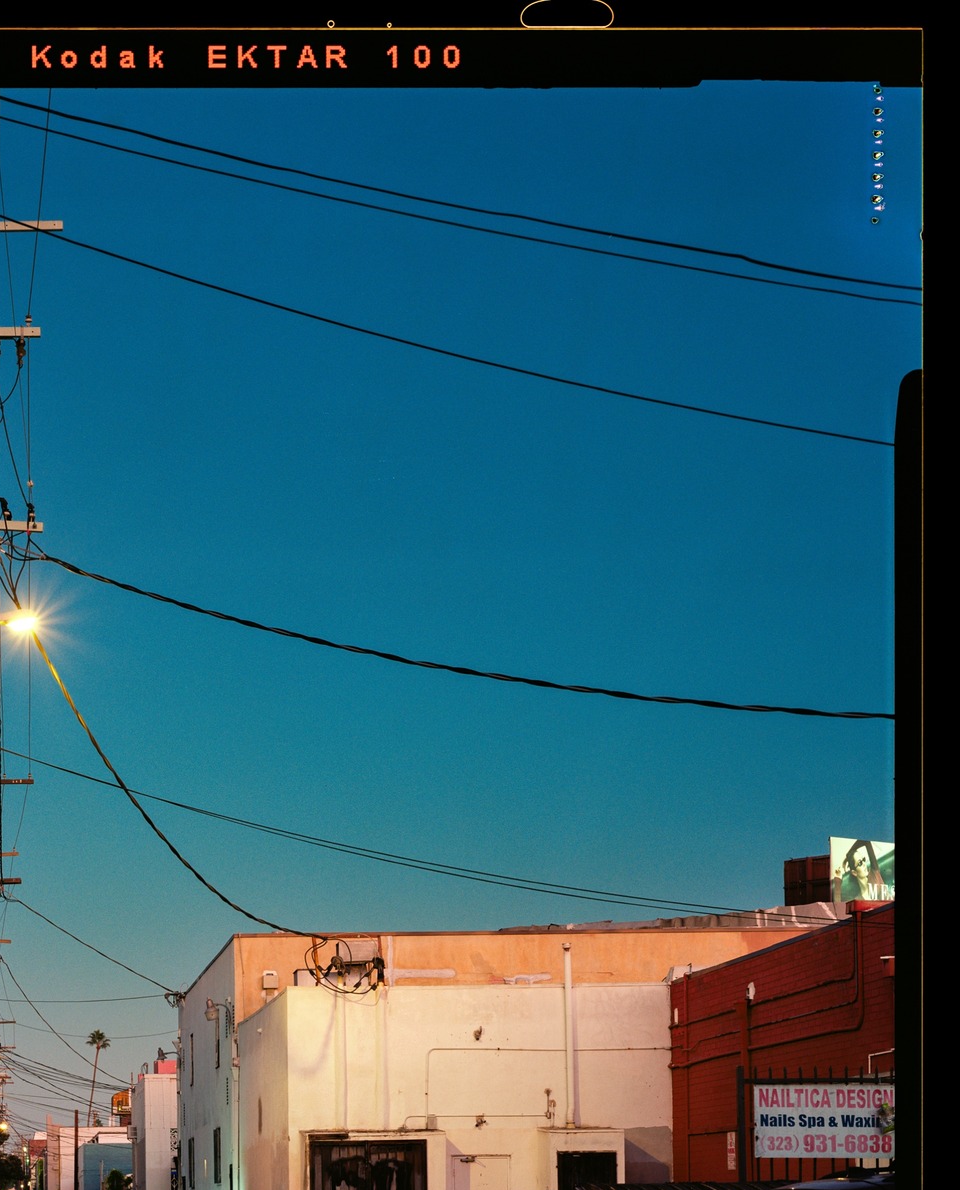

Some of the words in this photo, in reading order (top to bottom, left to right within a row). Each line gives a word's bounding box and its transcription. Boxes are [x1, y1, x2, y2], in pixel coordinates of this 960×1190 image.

[758, 1088, 831, 1108] NAILTICA
[836, 1089, 895, 1109] DESIGN
[760, 1114, 795, 1127] Nails
[799, 1114, 825, 1128] Spa
[828, 1114, 838, 1128] &
[840, 1114, 883, 1128] Waxi
[760, 1135, 800, 1153] (323)
[803, 1134, 893, 1153] 931-6838
